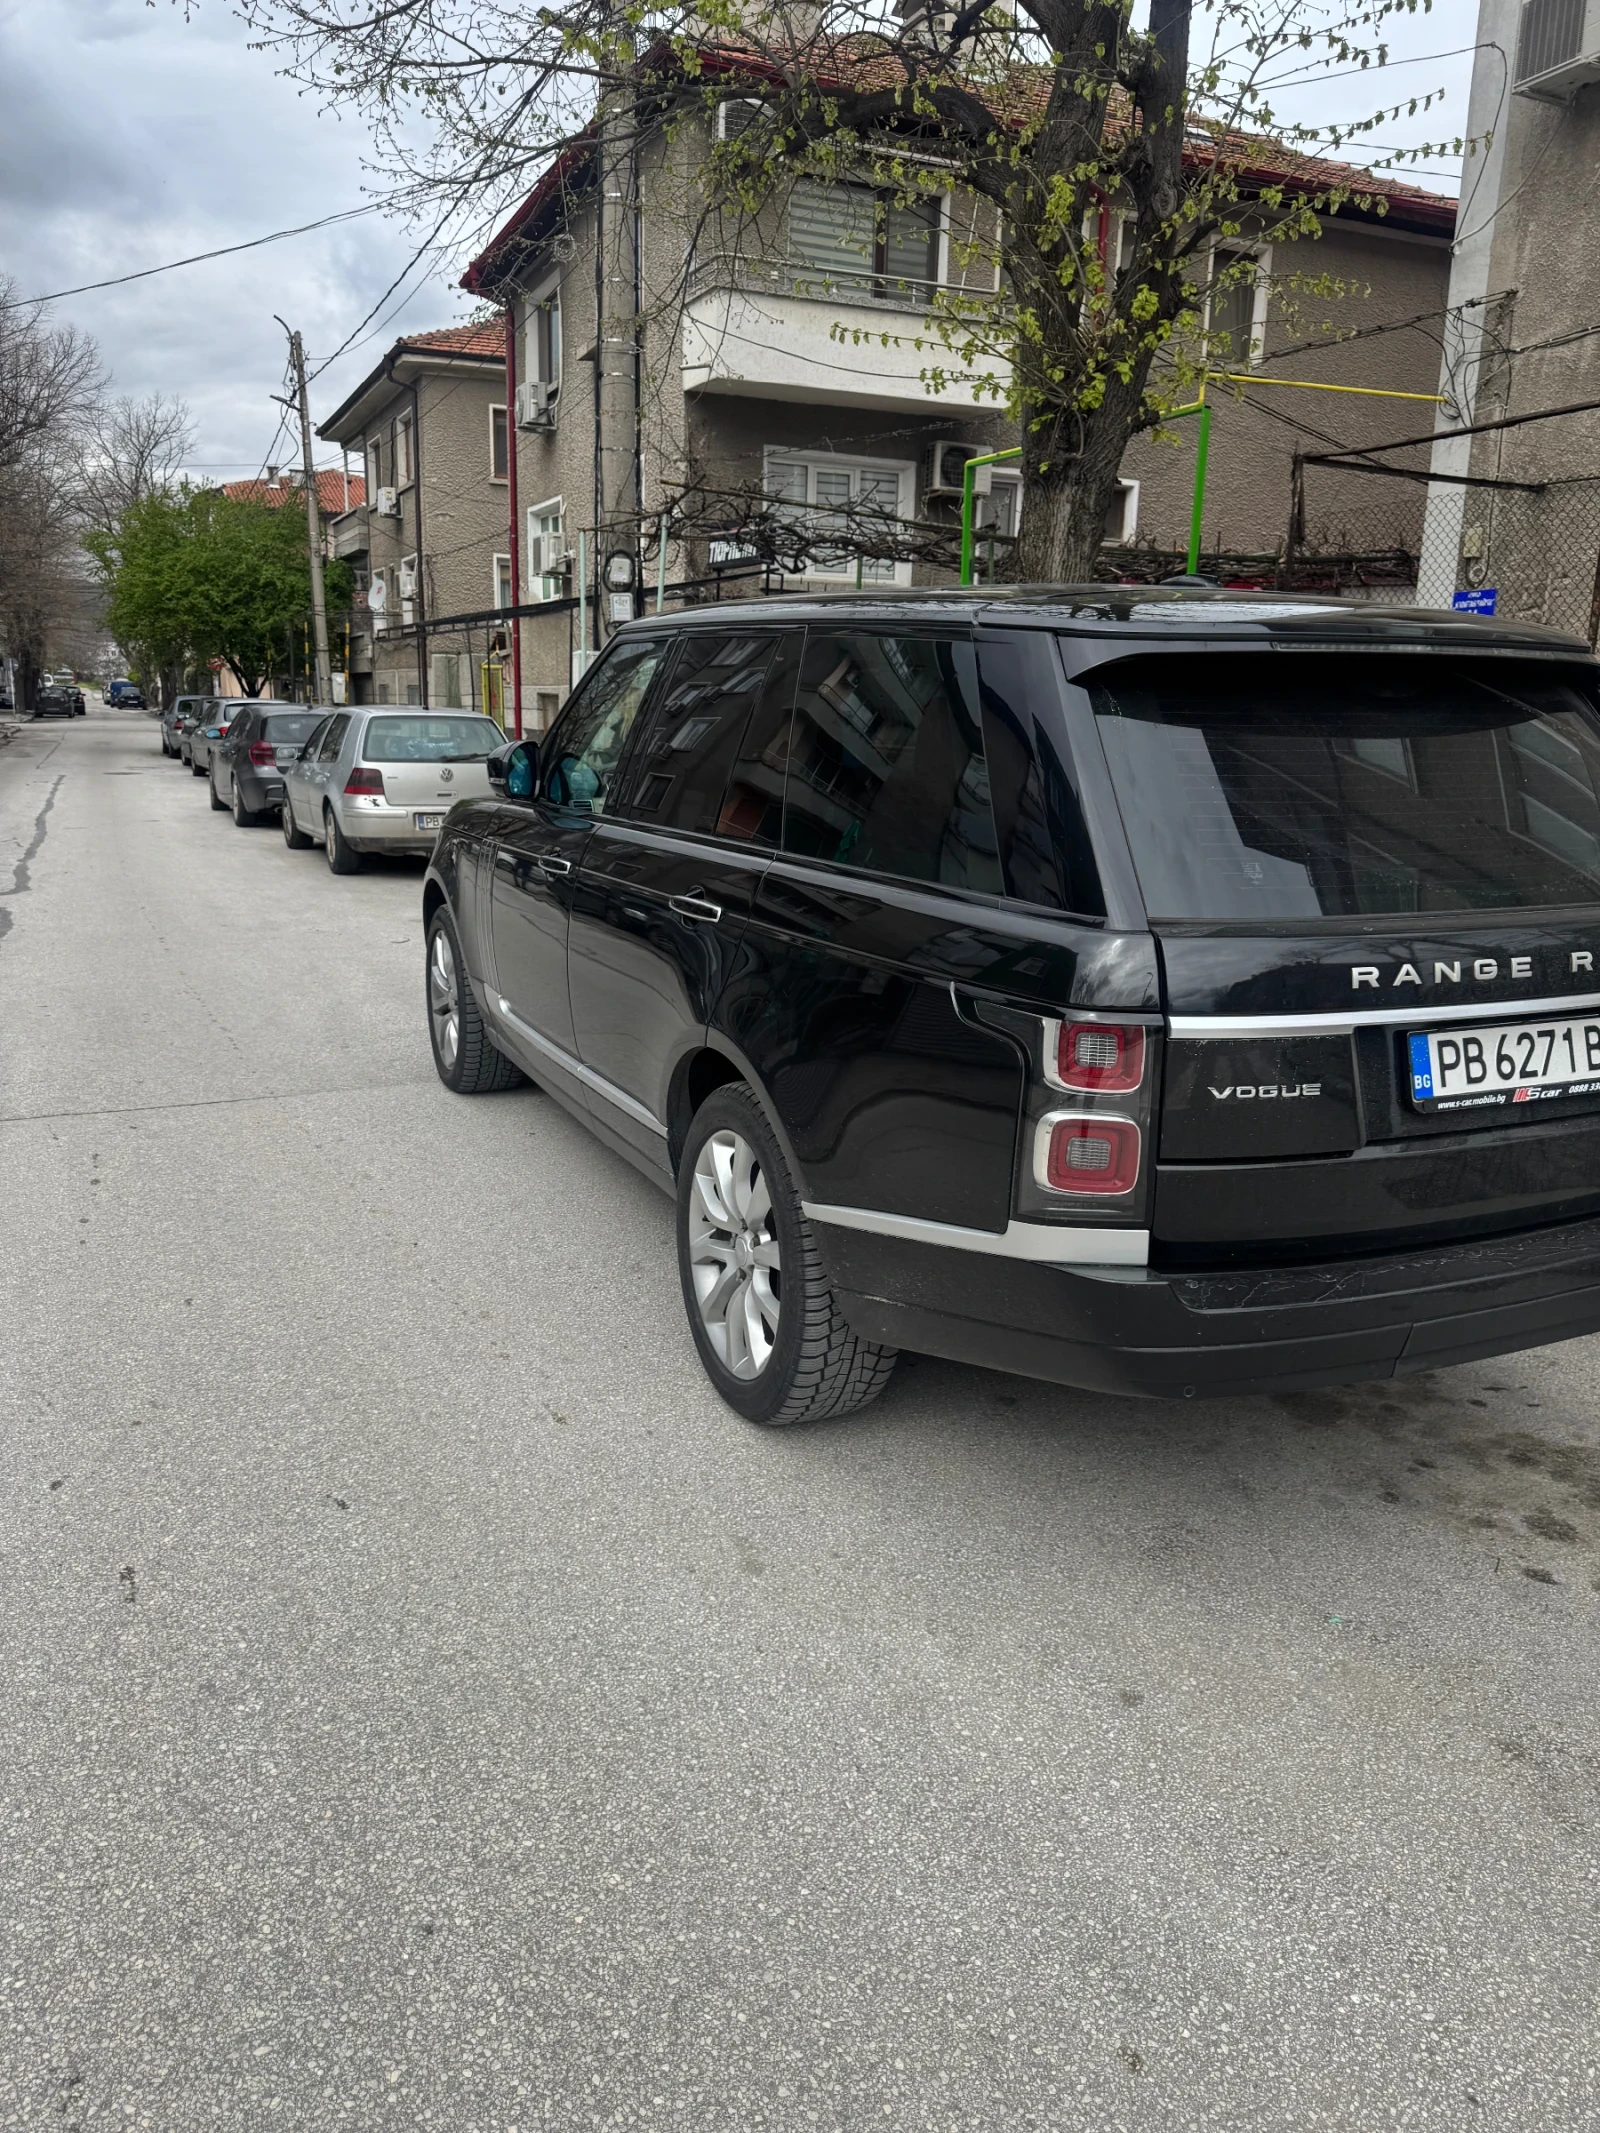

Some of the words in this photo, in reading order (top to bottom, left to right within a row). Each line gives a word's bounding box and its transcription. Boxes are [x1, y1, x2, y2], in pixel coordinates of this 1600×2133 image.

[1351, 956, 1533, 989] RANGE
[1437, 1037, 1487, 1088] PB
[1495, 1027, 1576, 1081] 6271
[1207, 1083, 1322, 1099] VOGUE
[1414, 1074, 1431, 1090] BG
[1437, 1094, 1507, 1110] www.s-car.mobile.bg
[1568, 1083, 1588, 1094] 0888
